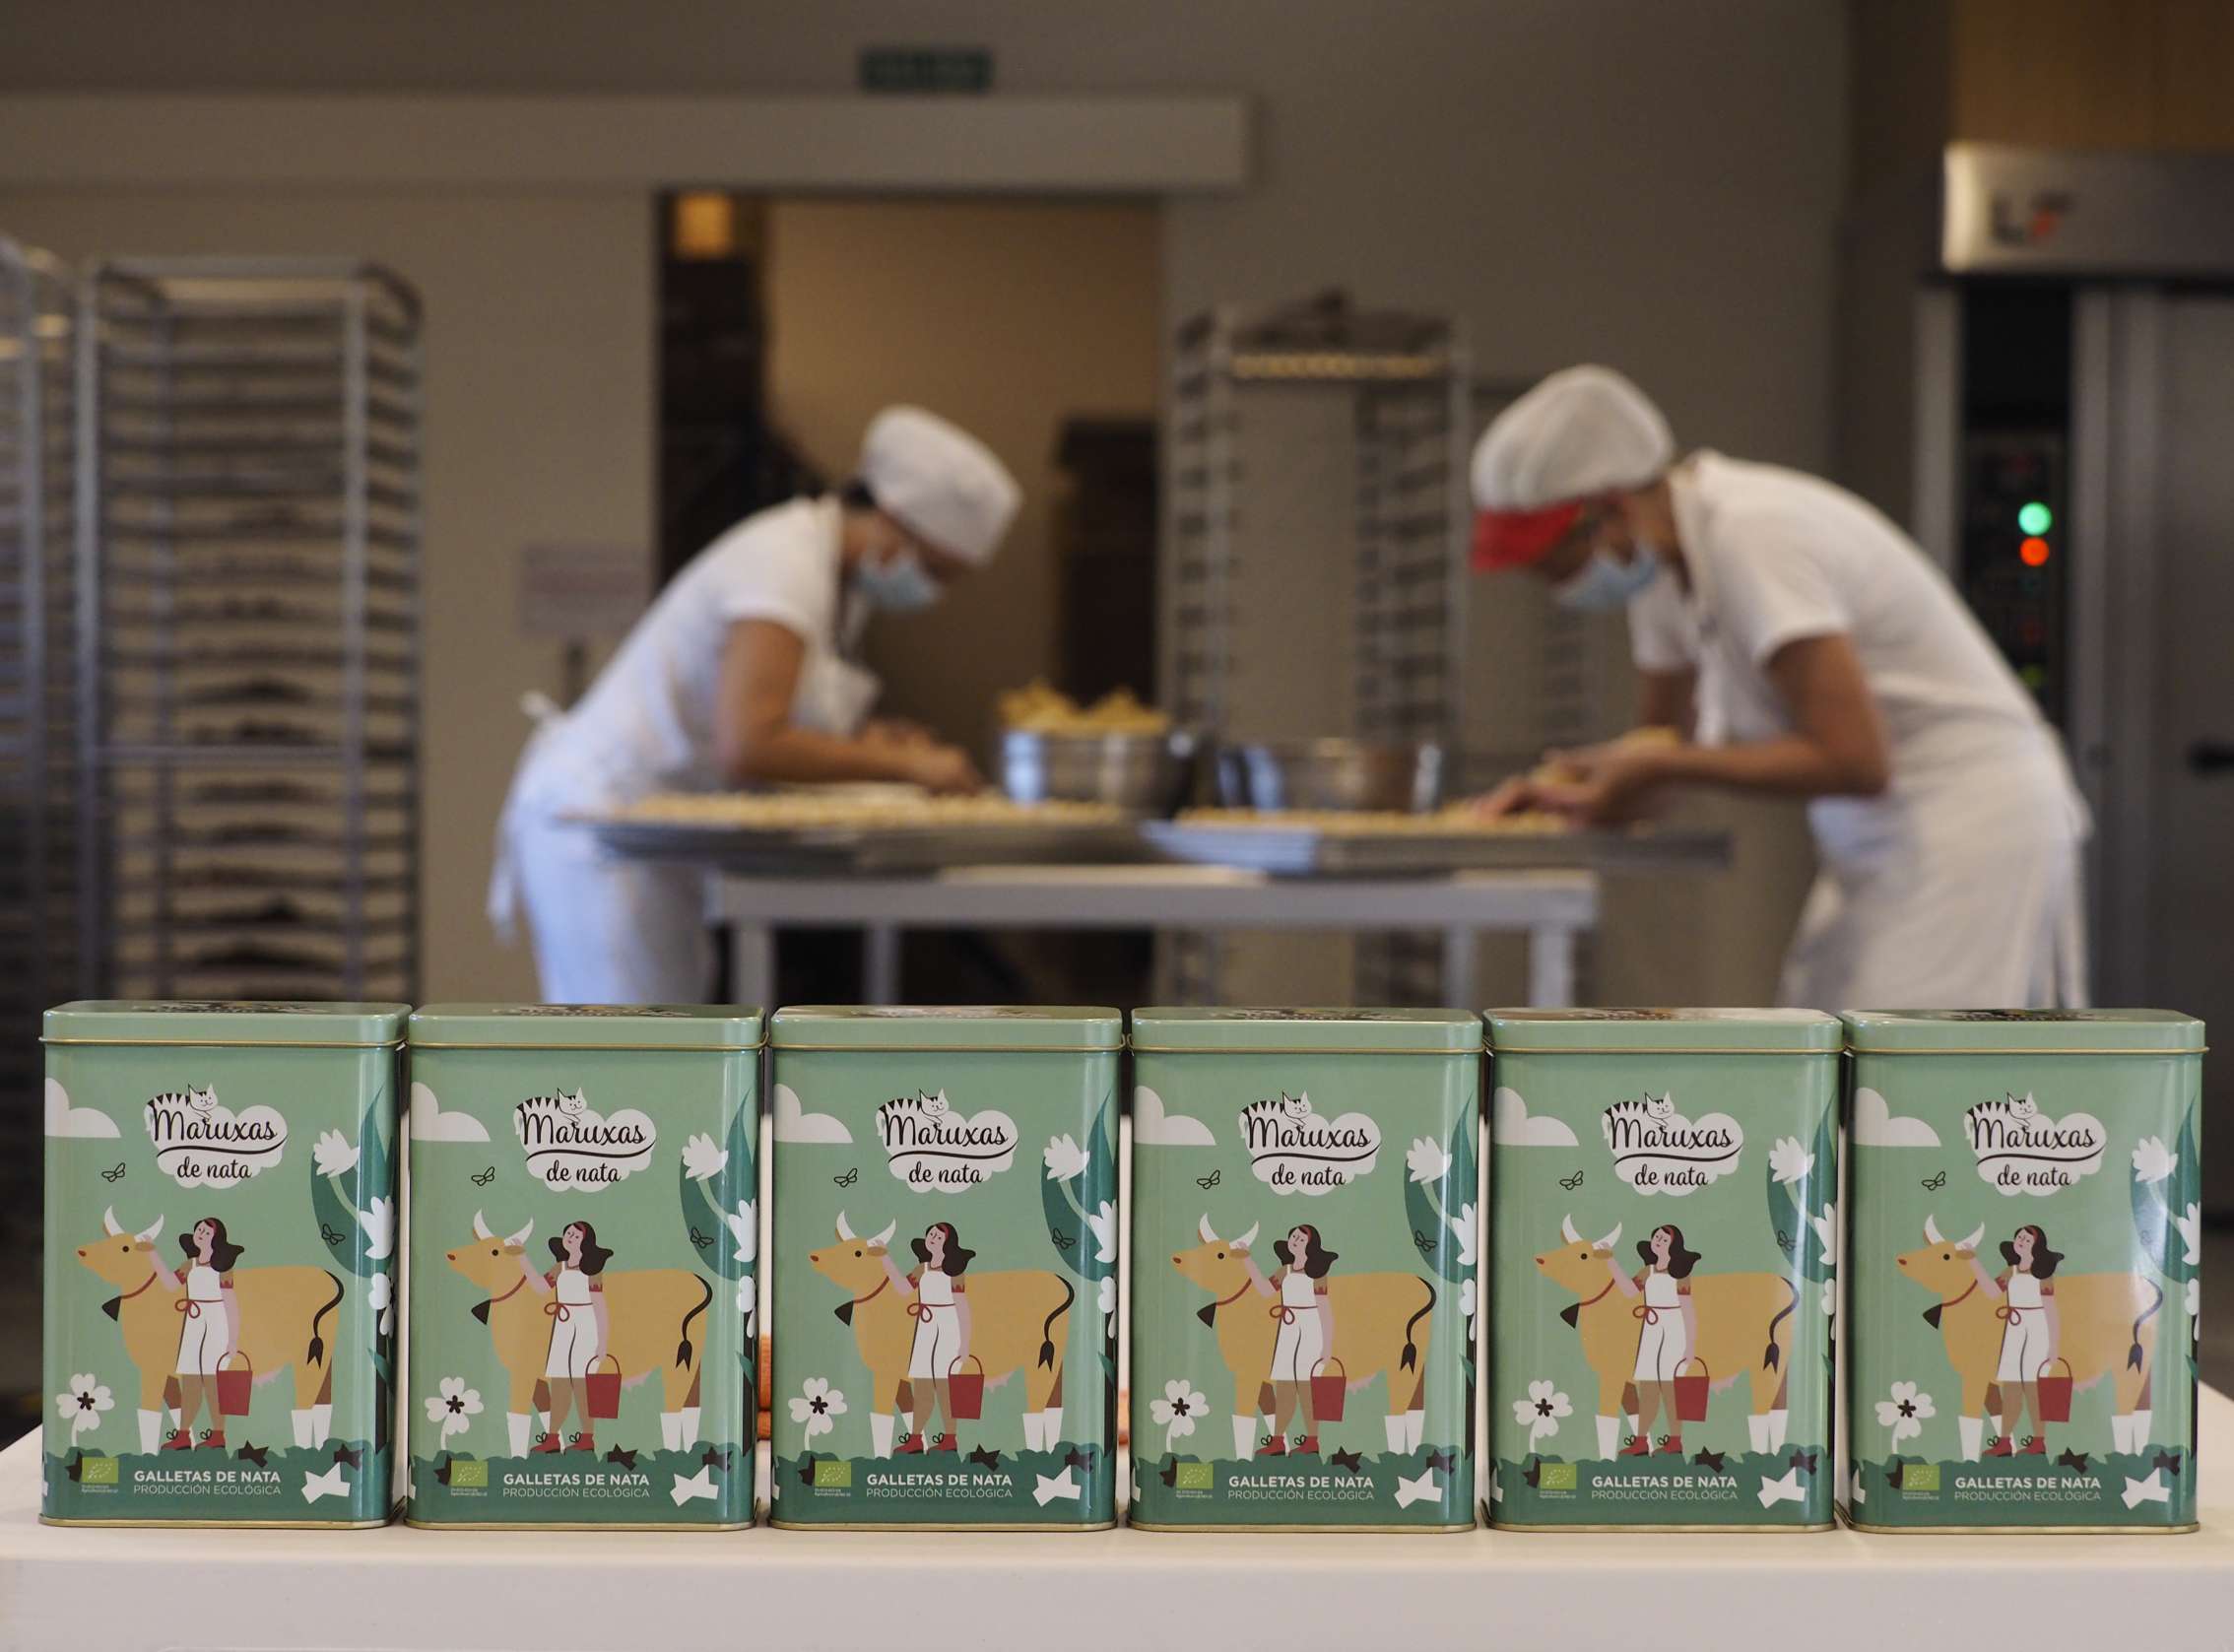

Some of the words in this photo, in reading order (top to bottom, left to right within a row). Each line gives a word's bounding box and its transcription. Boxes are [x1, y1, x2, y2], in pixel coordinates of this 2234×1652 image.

[154, 1105, 277, 1142] Maruxas
[523, 1109, 646, 1146] Maruxas
[885, 1110, 1008, 1147] Maruxas
[1248, 1112, 1371, 1149] Maruxas
[1610, 1113, 1734, 1150] Maruxas
[1973, 1113, 2096, 1150] Maruxas
[177, 1156, 201, 1178] de
[207, 1159, 251, 1178] nata
[547, 1160, 570, 1182] de
[576, 1163, 621, 1182] nata
[908, 1161, 932, 1183] de
[938, 1164, 982, 1183] nata
[1272, 1163, 1295, 1185] de
[1301, 1166, 1346, 1185] nata
[1634, 1164, 1658, 1186] de
[1664, 1167, 1708, 1186] nata
[1997, 1164, 2020, 1186] de
[2026, 1167, 2070, 1186] nata
[134, 1471, 211, 1483] GALLETAS
[216, 1471, 236, 1483] DE
[241, 1471, 281, 1483] NATA
[503, 1474, 580, 1486] GALLETAS
[585, 1474, 606, 1486] DE
[611, 1474, 650, 1486] NATA
[867, 1475, 943, 1487] GALLETAS
[948, 1475, 968, 1487] DE
[973, 1475, 1012, 1487] NATA
[1228, 1477, 1304, 1488] GALLETAS
[1309, 1477, 1330, 1488] DE
[1334, 1477, 1373, 1488] NATA
[1592, 1477, 1668, 1488] GALLETAS
[1673, 1477, 1693, 1488] DE
[1698, 1477, 1737, 1488] NATA
[1955, 1478, 2031, 1489] GALLETAS
[2036, 1478, 2057, 1489] DE
[2061, 1478, 2100, 1489] NATA
[134, 1483, 210, 1495] PRODUCCIÓN
[214, 1484, 281, 1495] ECOLÓGICA
[503, 1486, 579, 1498] PRODUCCIÓN
[583, 1487, 650, 1498] ECOLÓGICA
[867, 1487, 942, 1498] PRODUCCIÓN
[945, 1487, 1012, 1498] ECOLÓGICA
[1228, 1488, 1303, 1500] PRODUCCIÓN
[1306, 1489, 1373, 1500] ECOLÓGICA
[1592, 1488, 1667, 1500] PRODUCCIÓN
[1670, 1489, 1737, 1500] ECOLÓGICA
[1955, 1489, 2030, 1501] PRODUCCIÓN
[2033, 1490, 2100, 1501] ECOLÓGICA
